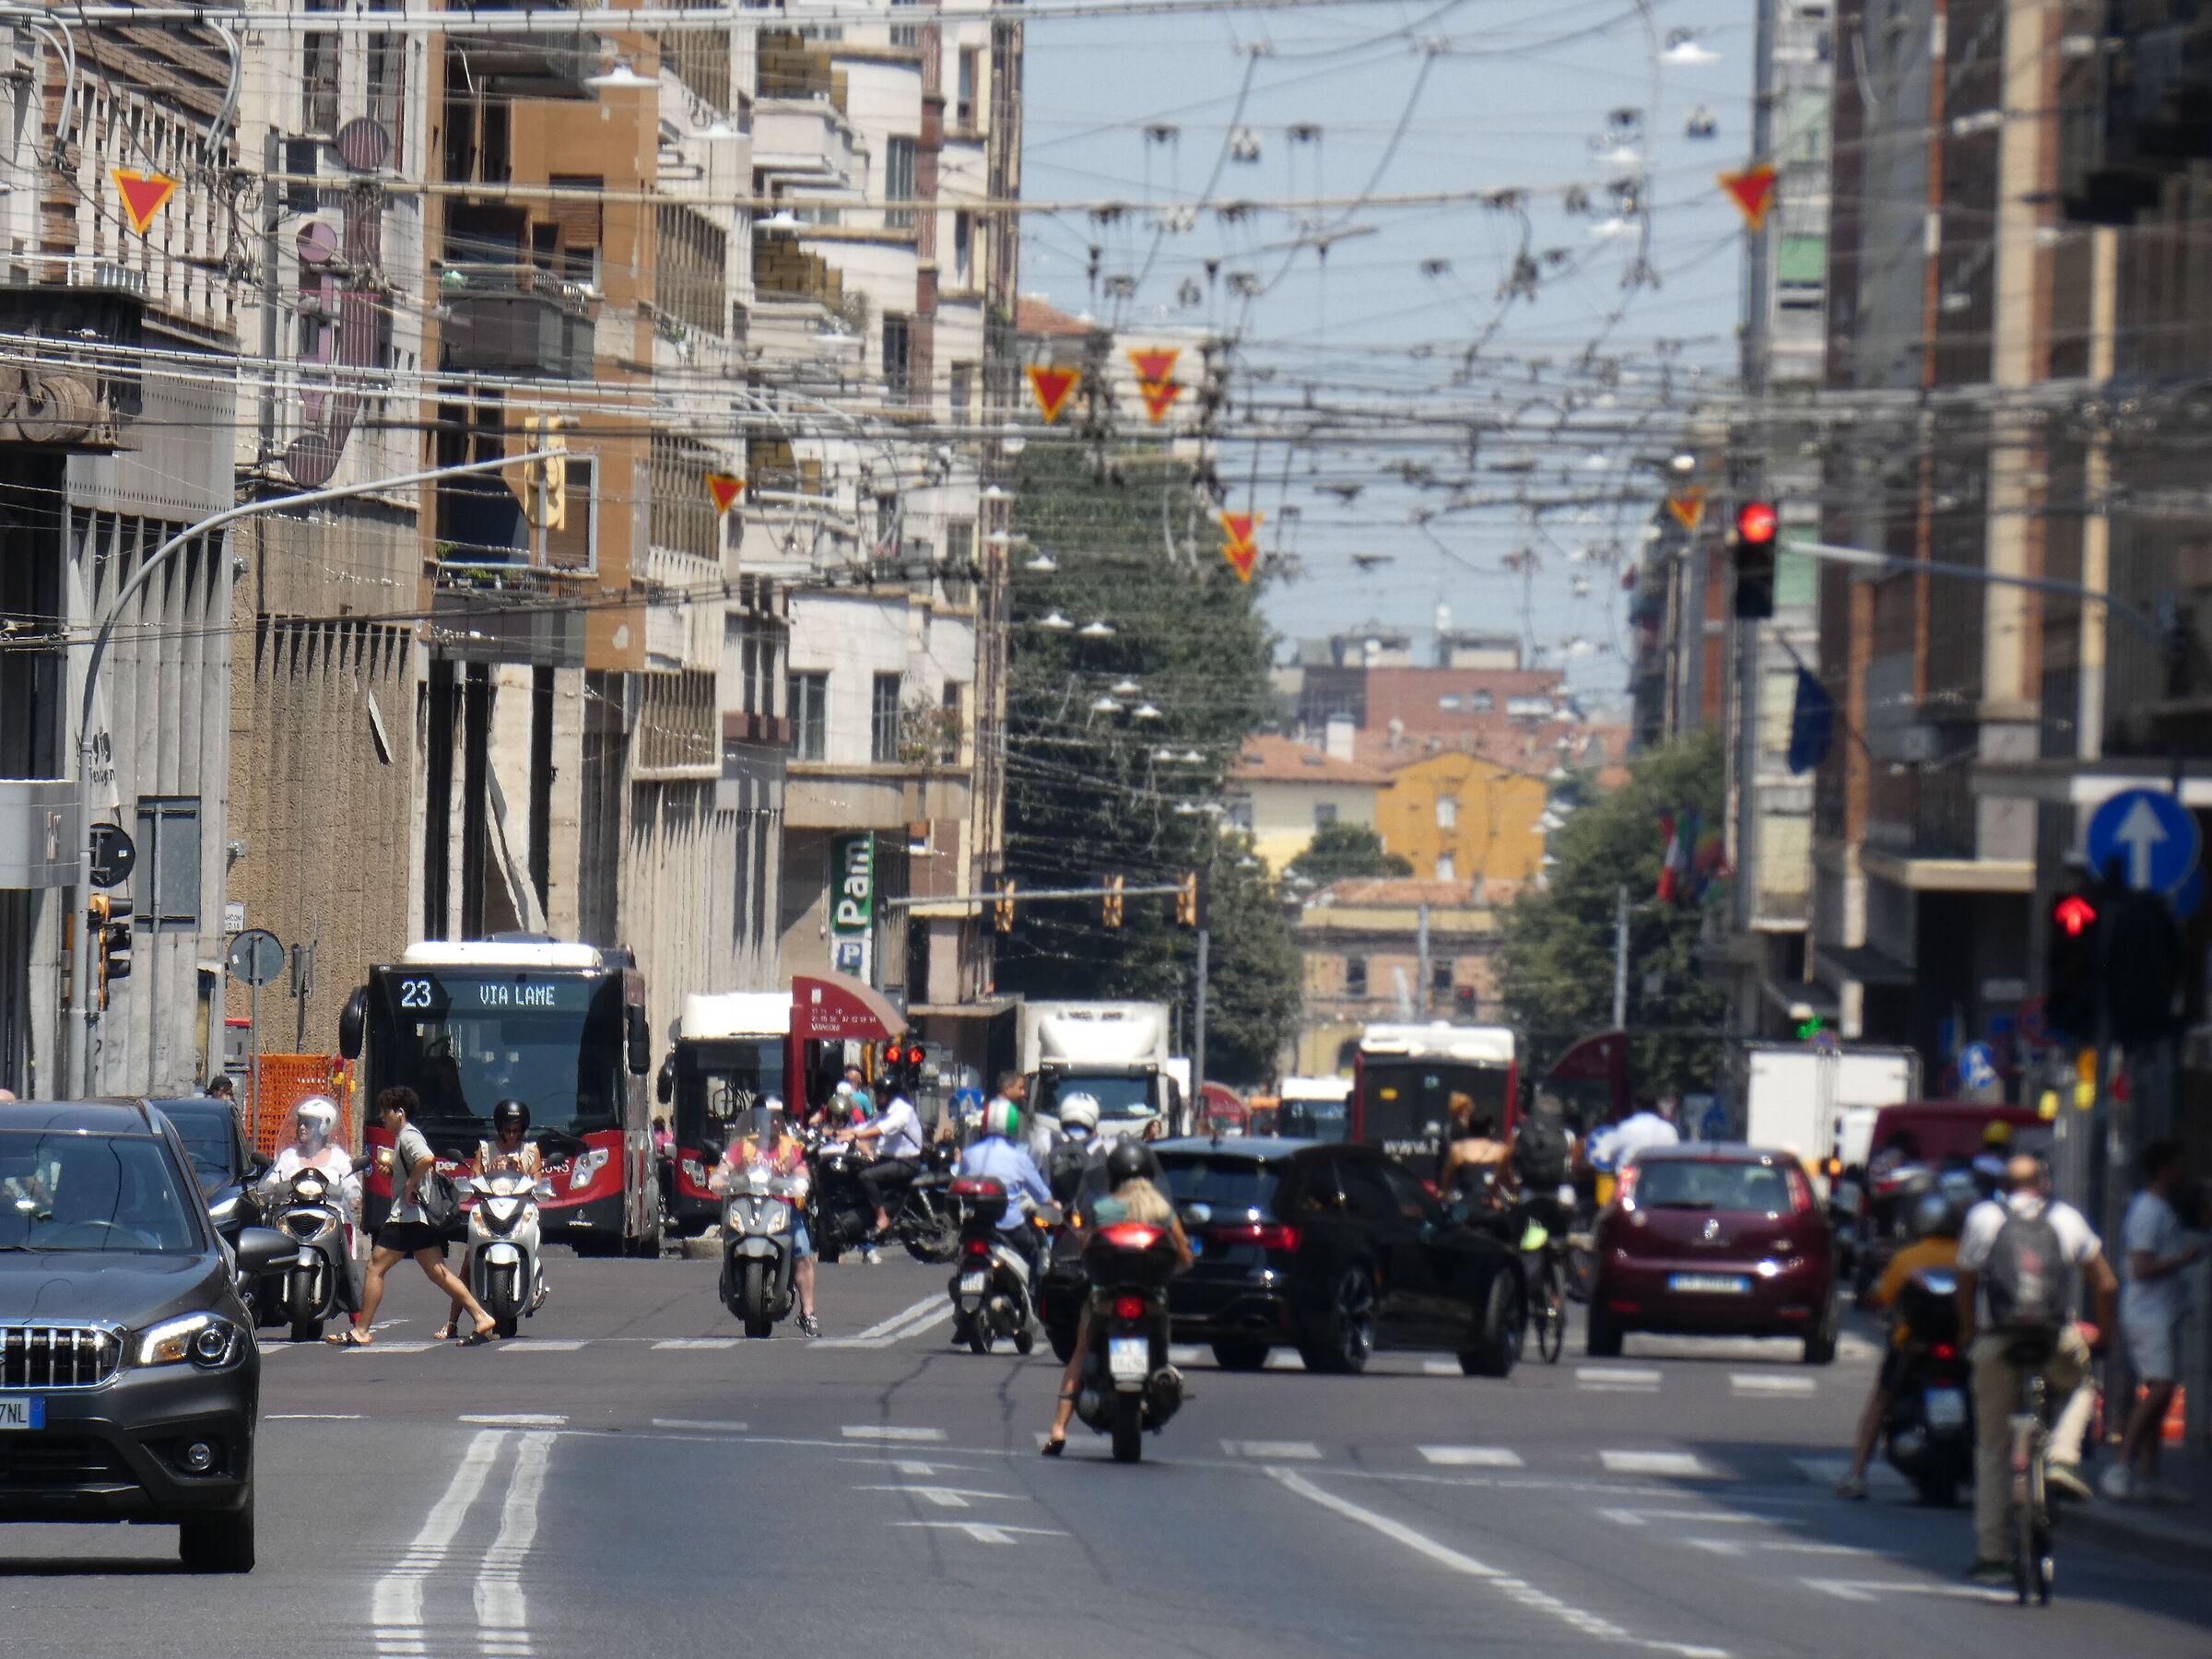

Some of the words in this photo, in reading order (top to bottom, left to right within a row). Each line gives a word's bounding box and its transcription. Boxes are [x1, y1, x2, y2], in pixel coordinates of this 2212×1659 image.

[837, 840, 870, 925] Pam
[843, 943, 861, 964] P
[401, 980, 432, 1007] 23
[479, 984, 509, 1006] VIA
[514, 985, 556, 1006] LAME
